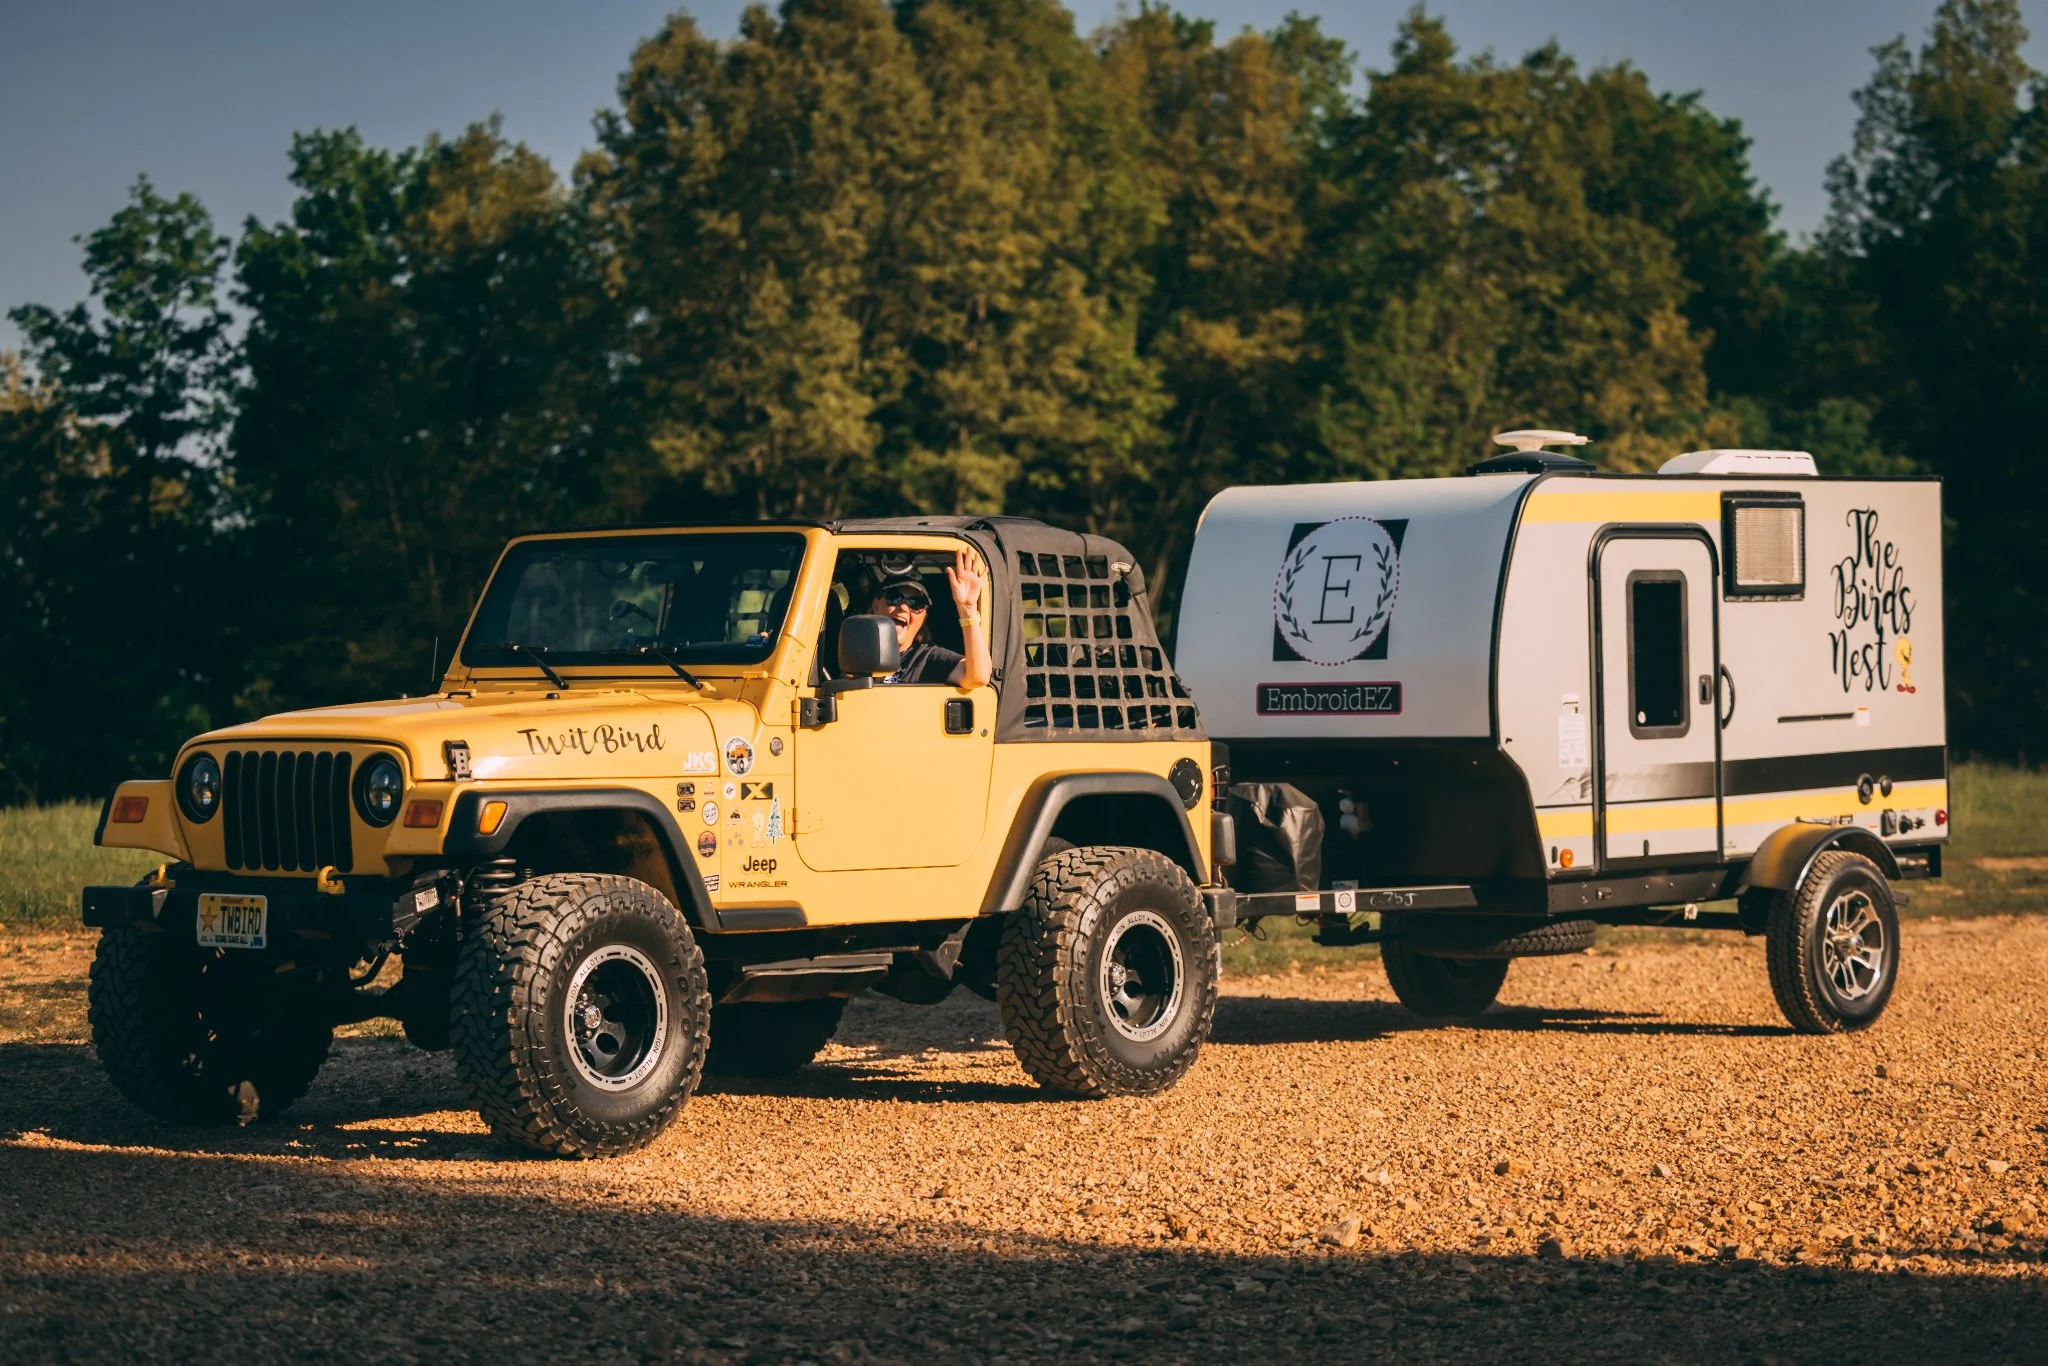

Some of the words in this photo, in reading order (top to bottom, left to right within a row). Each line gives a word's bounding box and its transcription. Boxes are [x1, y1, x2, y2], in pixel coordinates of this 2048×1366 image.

[1846, 505, 1899, 593] The
[1312, 554, 1362, 625] E
[1830, 556, 1917, 635] Birds
[1266, 686, 1393, 711] EmbroidEZ
[683, 751, 716, 773] JKS
[742, 855, 778, 875] Jeep
[728, 881, 789, 889] WRANGLER
[221, 905, 262, 935] TWBIRD
